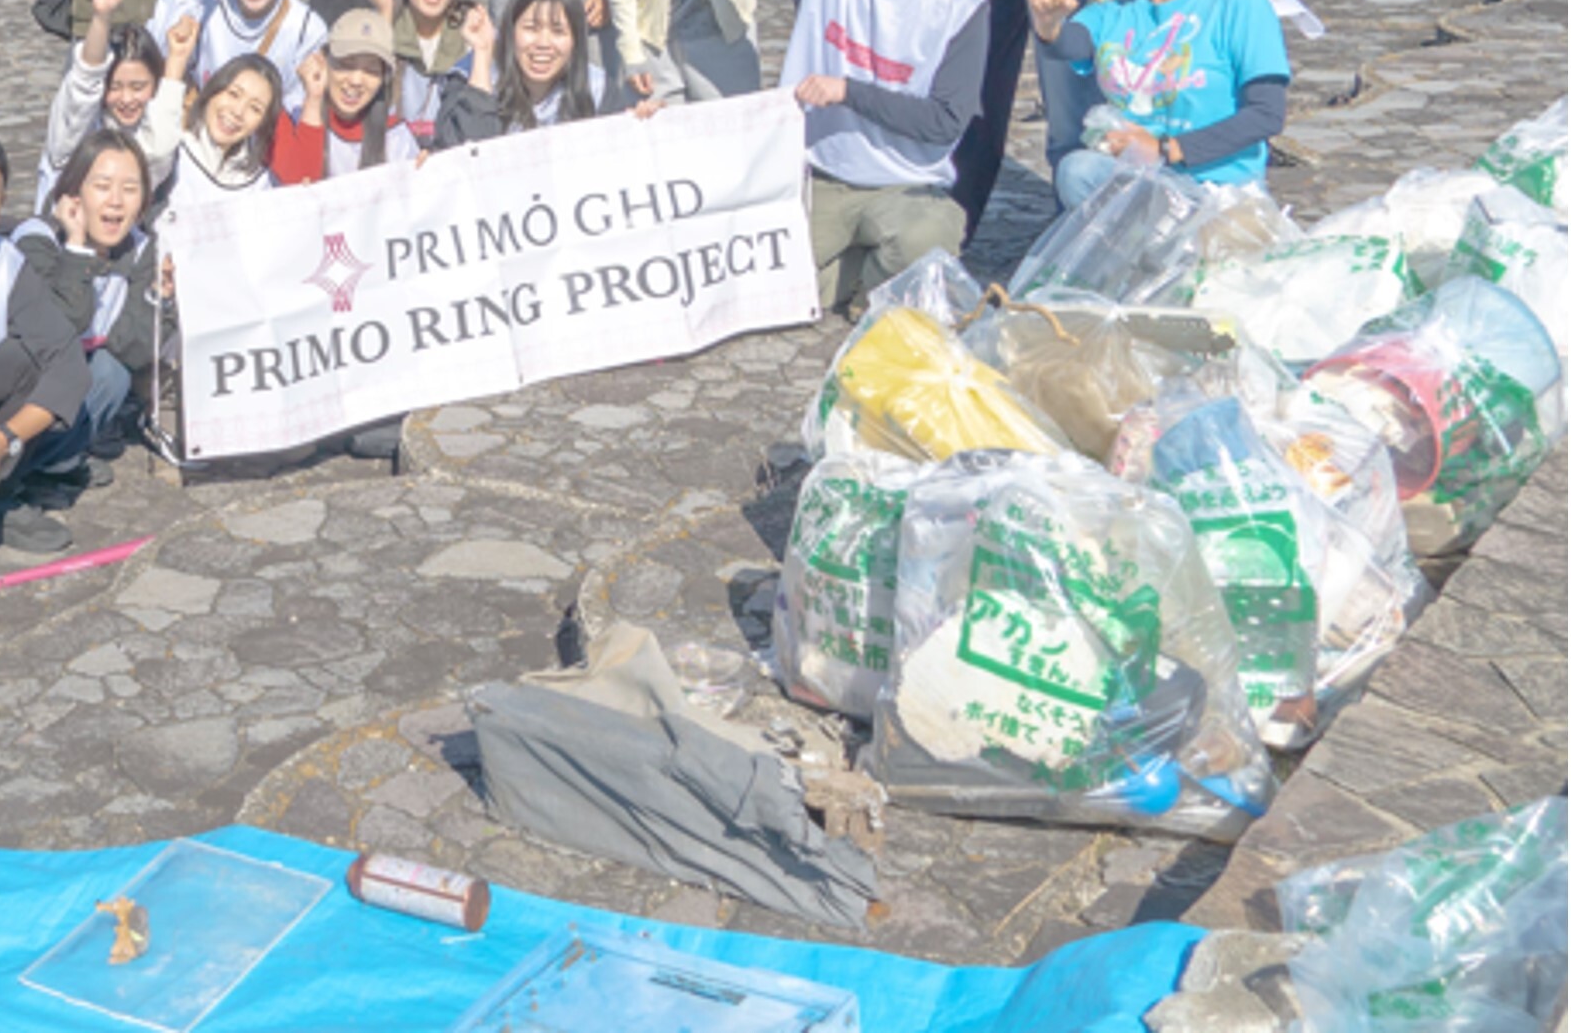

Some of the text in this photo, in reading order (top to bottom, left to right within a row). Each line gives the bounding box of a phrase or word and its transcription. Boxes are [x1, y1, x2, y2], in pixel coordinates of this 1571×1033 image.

[573, 178, 704, 236] GHD
[209, 228, 792, 398] PRIMO RING PROJECT
